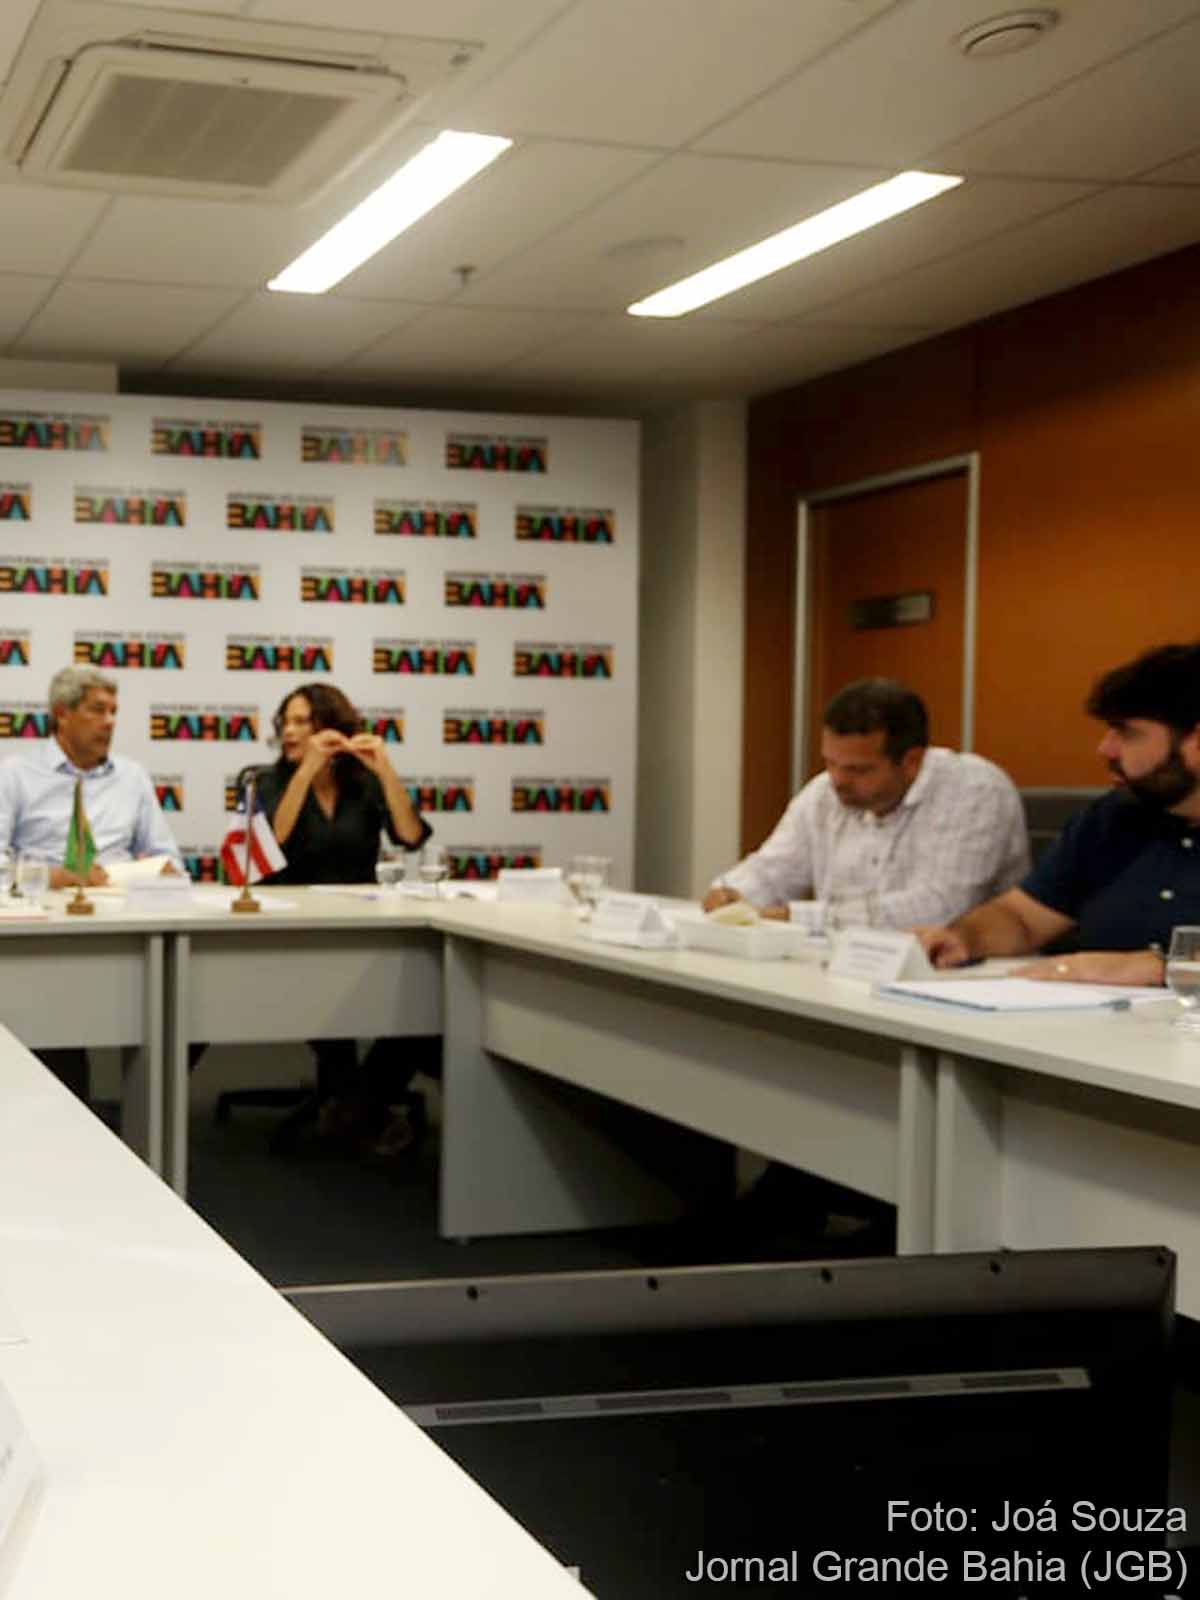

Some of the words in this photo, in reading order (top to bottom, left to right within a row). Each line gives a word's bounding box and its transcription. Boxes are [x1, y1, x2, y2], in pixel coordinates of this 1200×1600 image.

[152, 430, 261, 459] BAHIA
[446, 445, 548, 472] BAHIA
[75, 498, 188, 526] BAHIA
[227, 504, 335, 532] BAHIA
[374, 511, 480, 538] BAHIA
[516, 514, 615, 543] BAHIA
[151, 572, 261, 599] BAHIA
[301, 577, 406, 603] BAHIA
[445, 582, 547, 608] BAHIA
[75, 642, 187, 668] BAHIA
[226, 646, 333, 671] BAHIA
[373, 649, 477, 675] BAHIA
[514, 653, 614, 678] BAHIA
[150, 714, 259, 740] BAHIA
[444, 718, 546, 744] BAHIA
[513, 787, 612, 812] BAHIA
